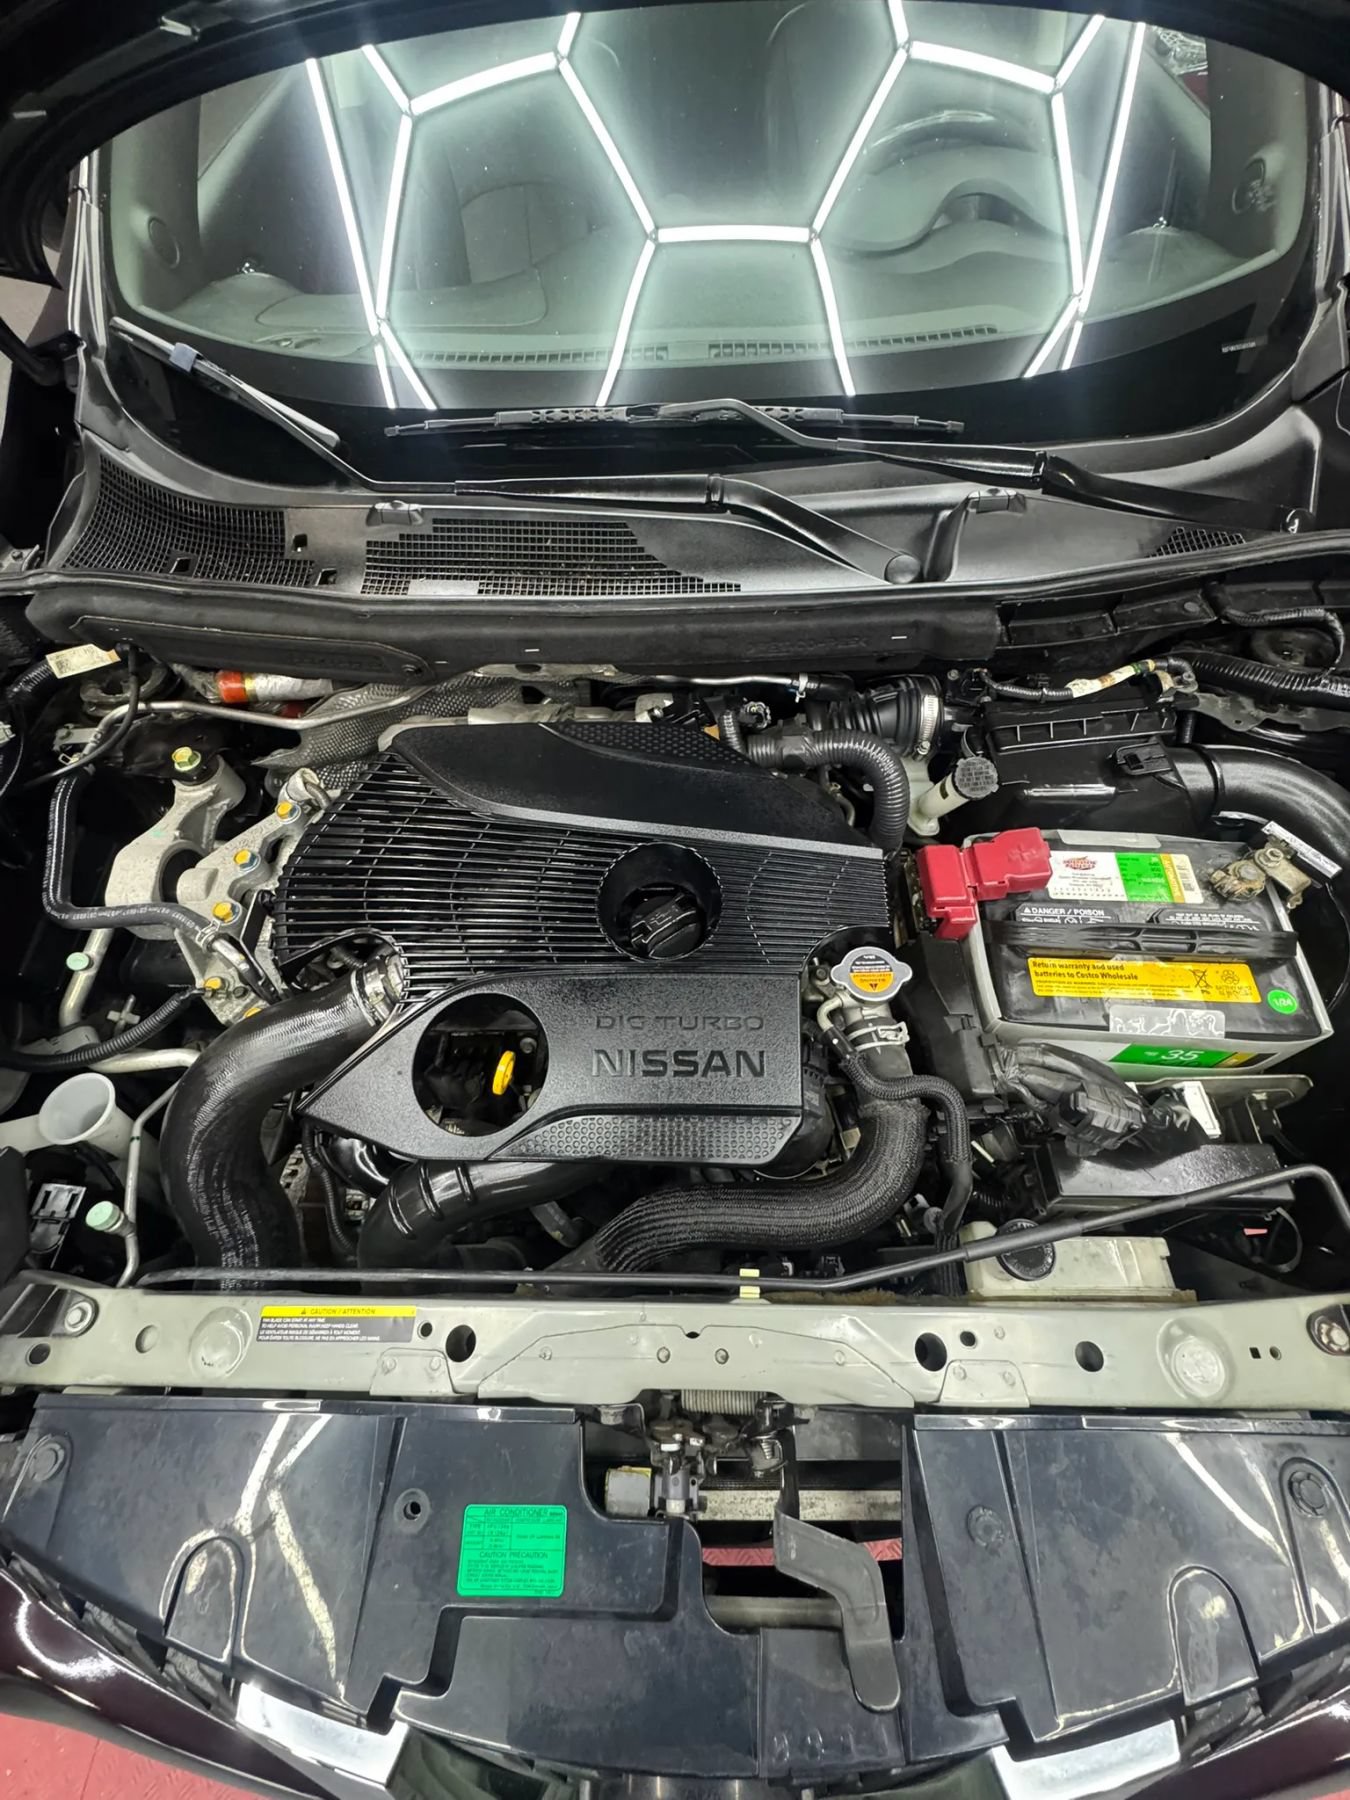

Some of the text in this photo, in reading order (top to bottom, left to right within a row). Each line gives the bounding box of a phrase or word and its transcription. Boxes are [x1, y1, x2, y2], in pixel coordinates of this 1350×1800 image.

[1032, 907, 1066, 915] DANGER
[1059, 963, 1090, 971] warranty
[1100, 972, 1138, 980] Wholesale
[595, 1015, 764, 1031] DIG TURBO
[1161, 1049, 1205, 1061] 35
[592, 1049, 767, 1078] NISSAN
[499, 1508, 548, 1517] CONDITIONER
